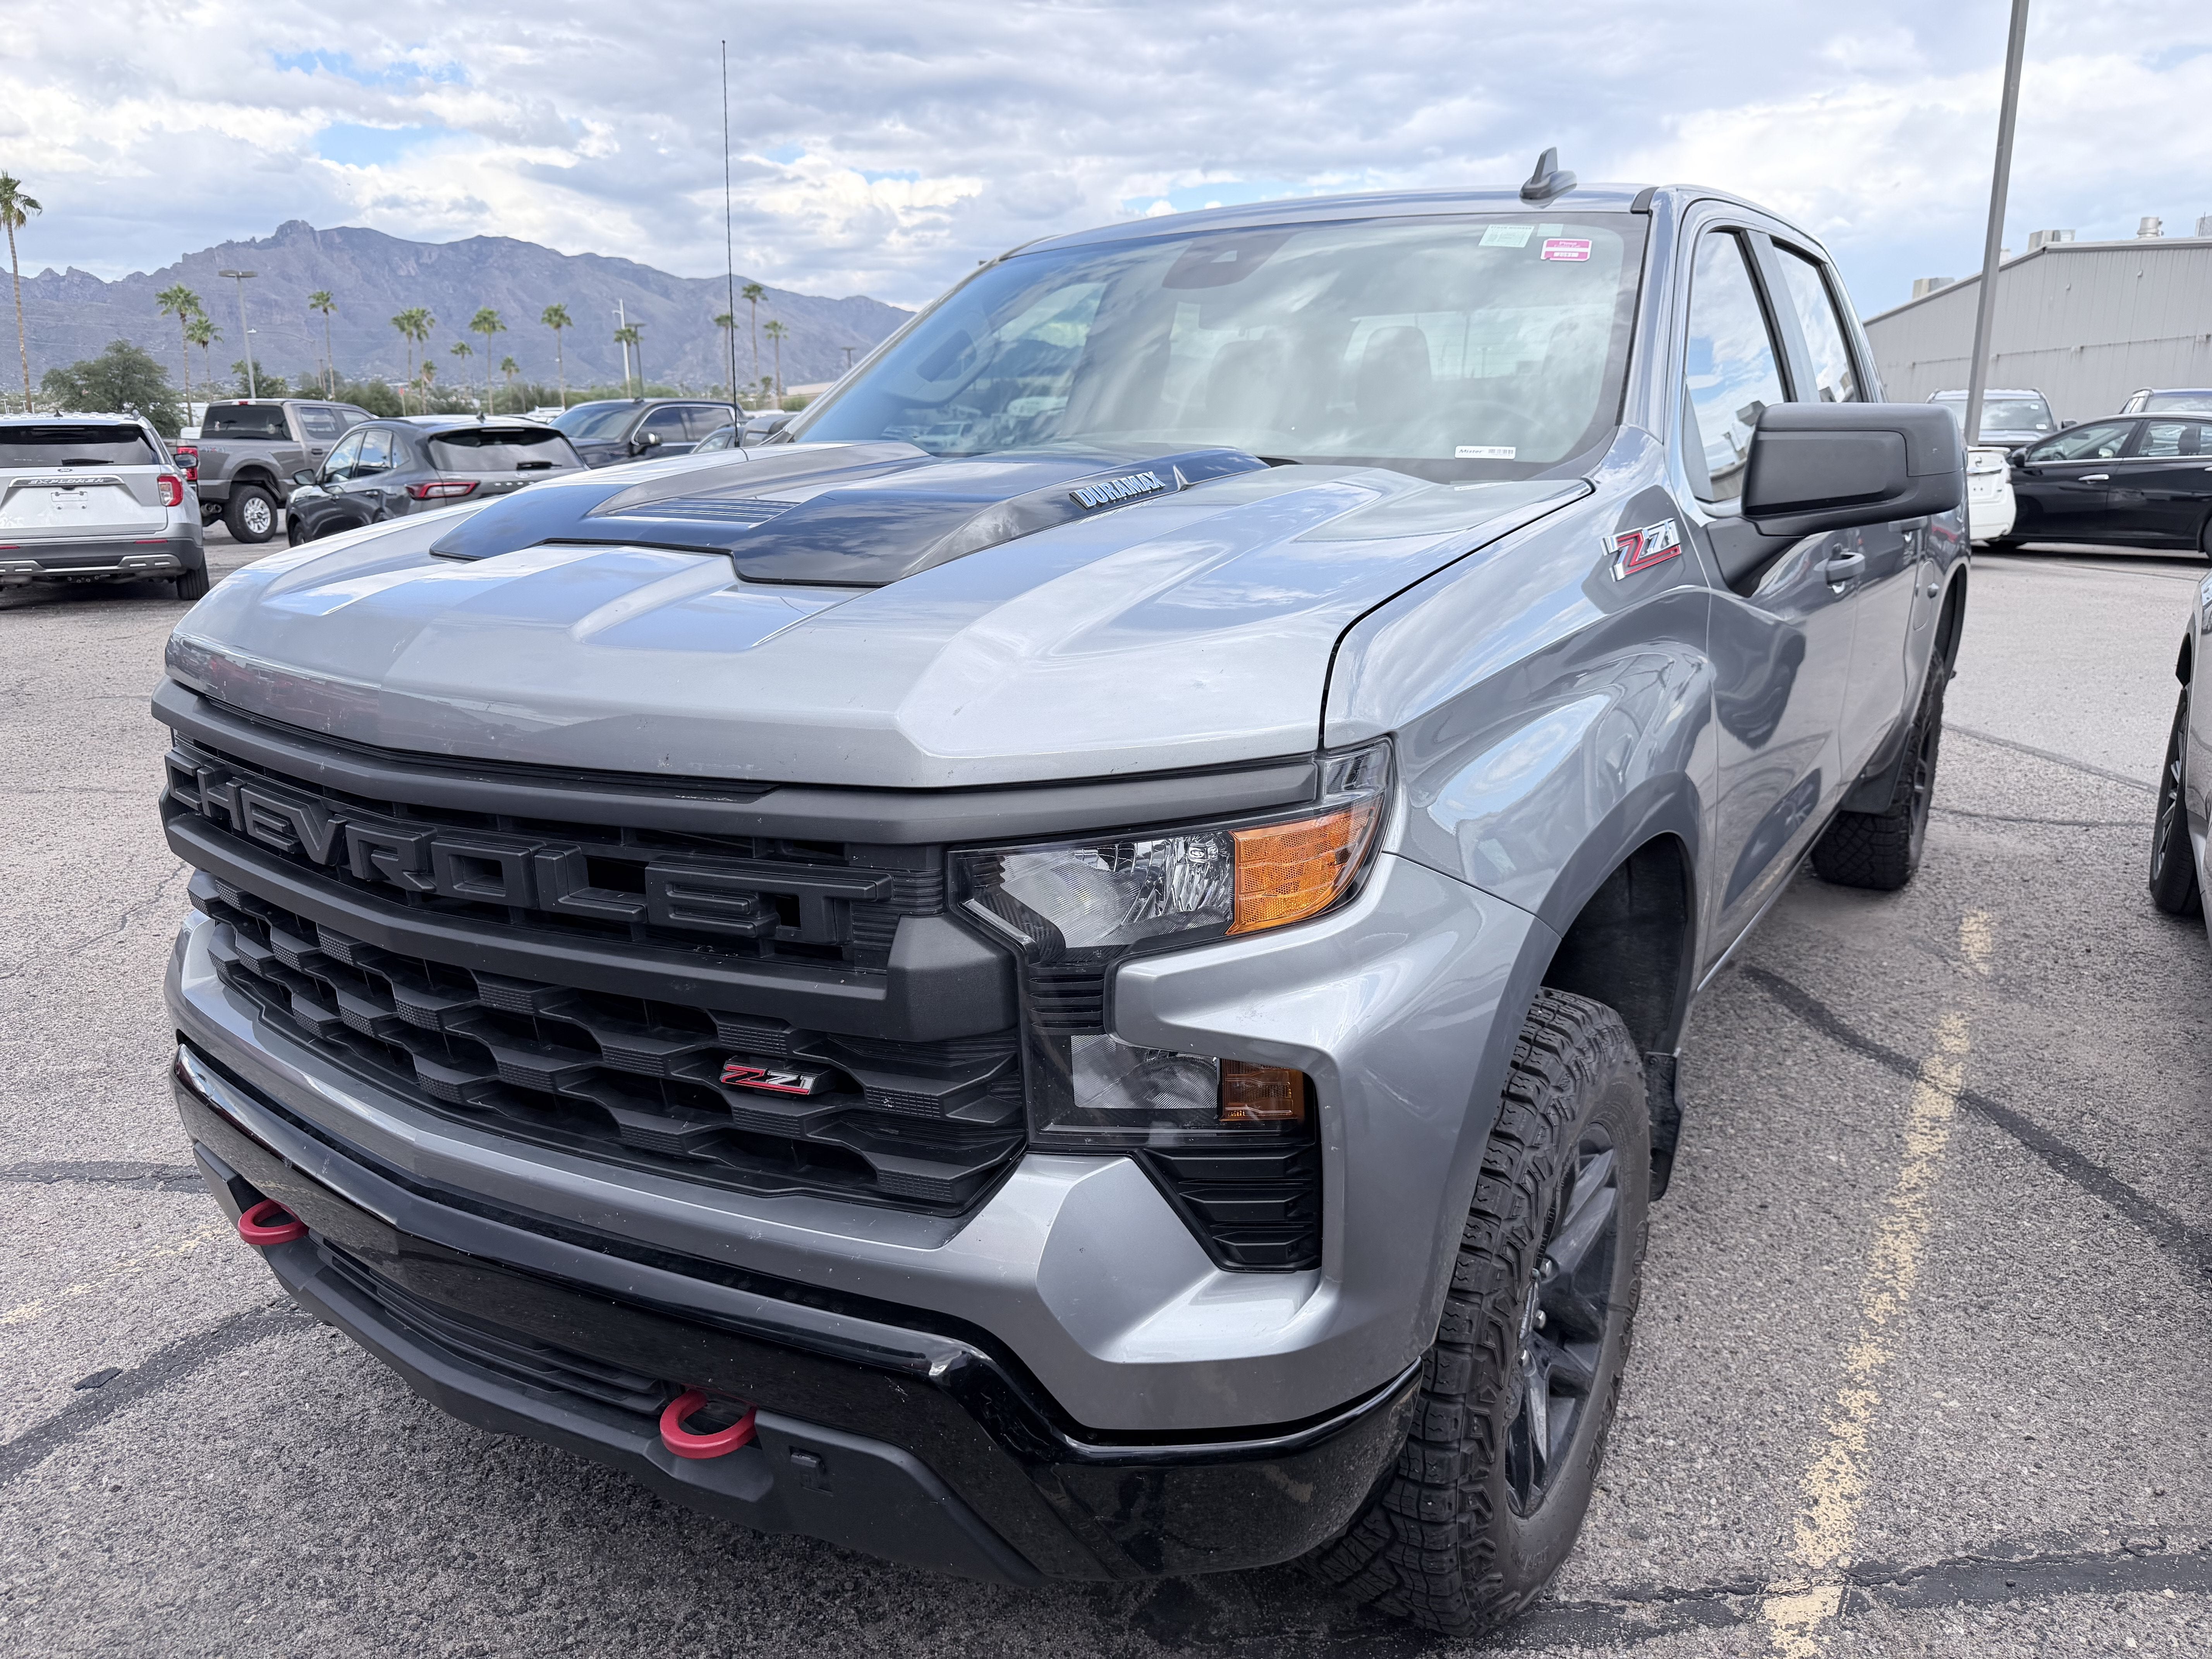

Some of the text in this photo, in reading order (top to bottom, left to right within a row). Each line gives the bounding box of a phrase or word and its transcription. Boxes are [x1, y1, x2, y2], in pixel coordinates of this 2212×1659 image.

[1074, 471, 1166, 507] DURAMAX
[1600, 518, 1681, 582] Z71
[165, 749, 891, 945] CHEVROLET
[720, 1064, 817, 1095] Z71
